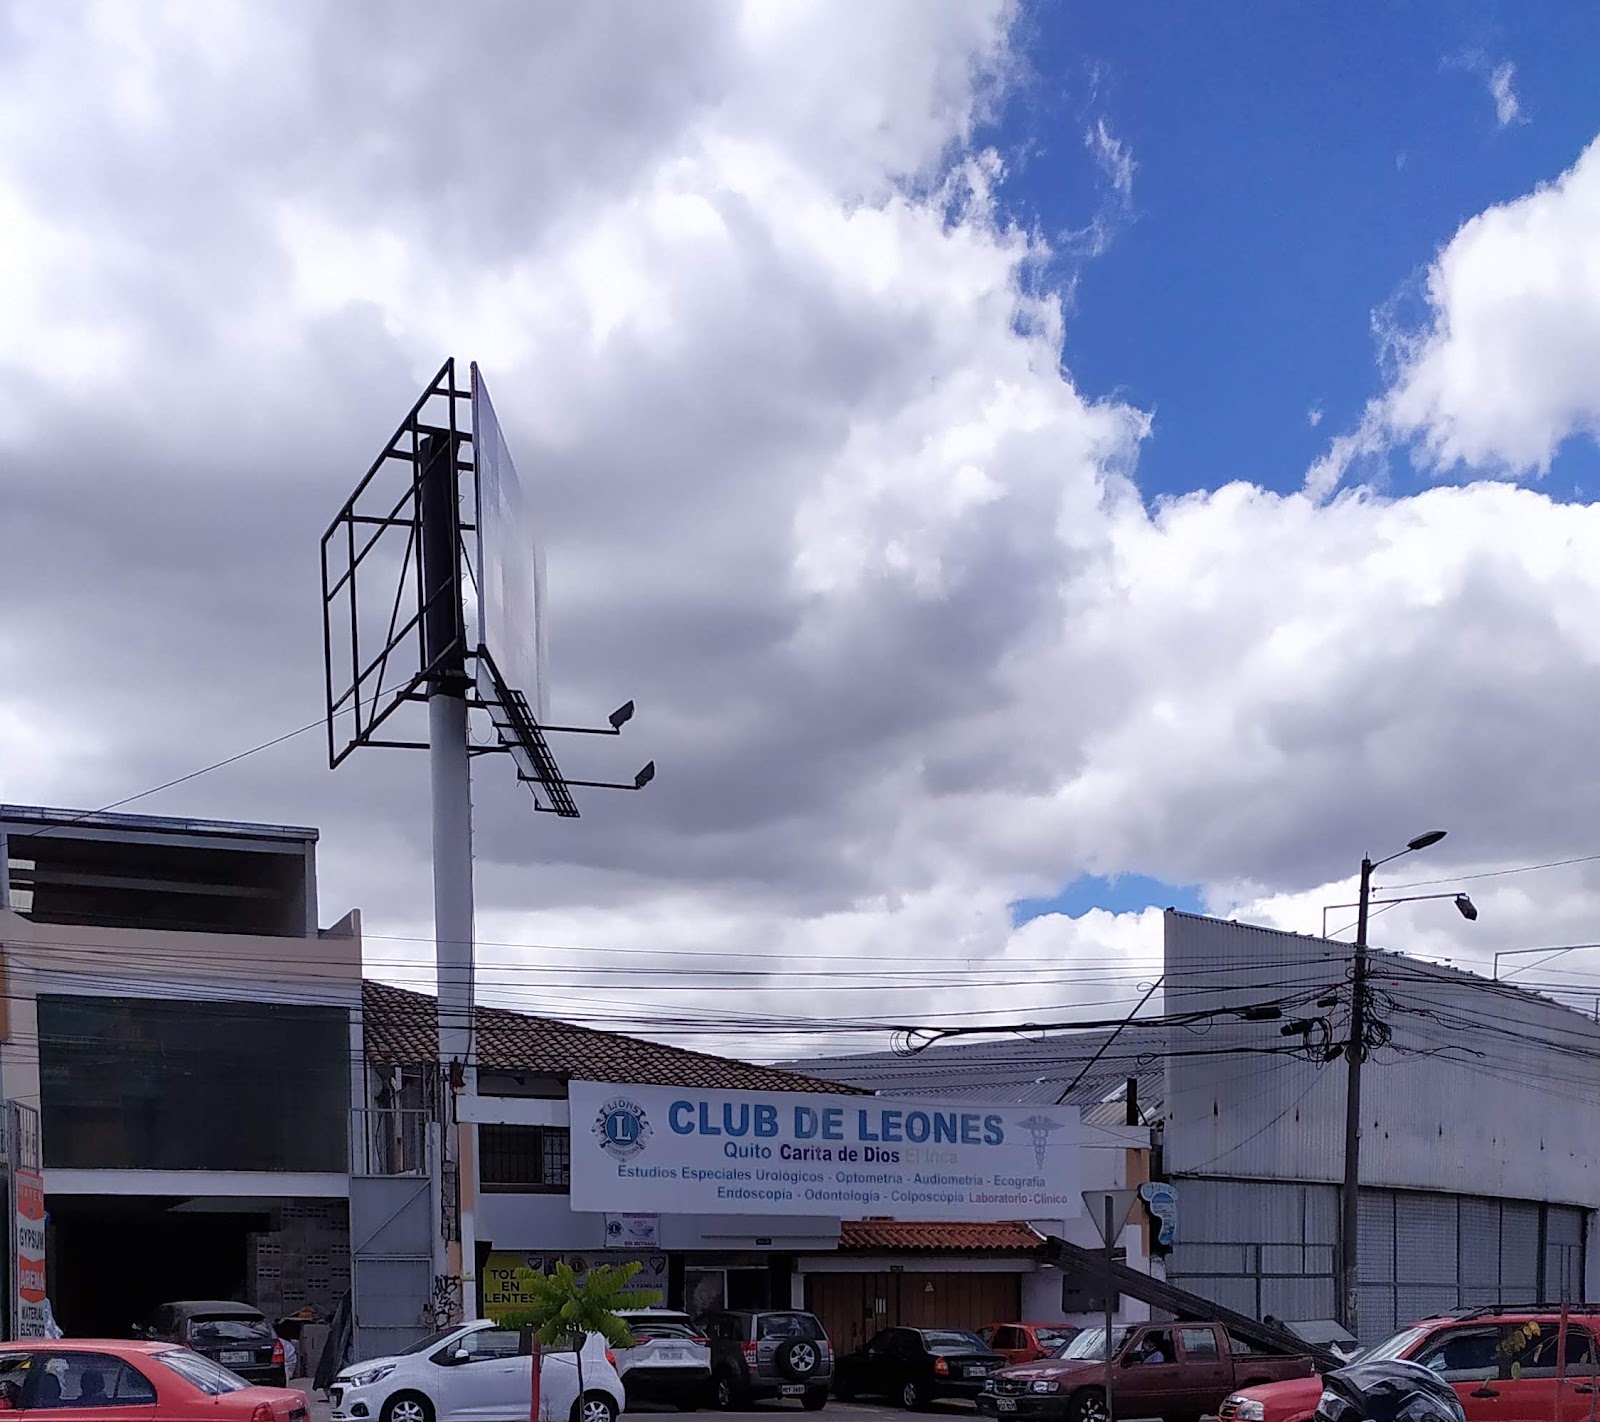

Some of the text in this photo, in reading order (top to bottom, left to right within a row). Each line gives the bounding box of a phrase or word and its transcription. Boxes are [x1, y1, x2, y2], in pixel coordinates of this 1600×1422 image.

[607, 1099, 641, 1115] LIONS
[614, 1115, 632, 1141] L
[668, 1100, 1005, 1146] CLUB DE LEONES
[724, 1141, 772, 1160] Quito
[780, 1143, 832, 1161] Carita
[838, 1146, 858, 1162] de
[864, 1146, 900, 1163] Dios
[617, 1164, 677, 1179] Estudios
[681, 1166, 752, 1182] Especiales
[756, 1168, 824, 1185] Urológicos
[20, 1227, 44, 1250] GYPSUM
[20, 1269, 45, 1291] ARENA
[502, 1281, 520, 1291] EN
[485, 1293, 536, 1303] LENTES
